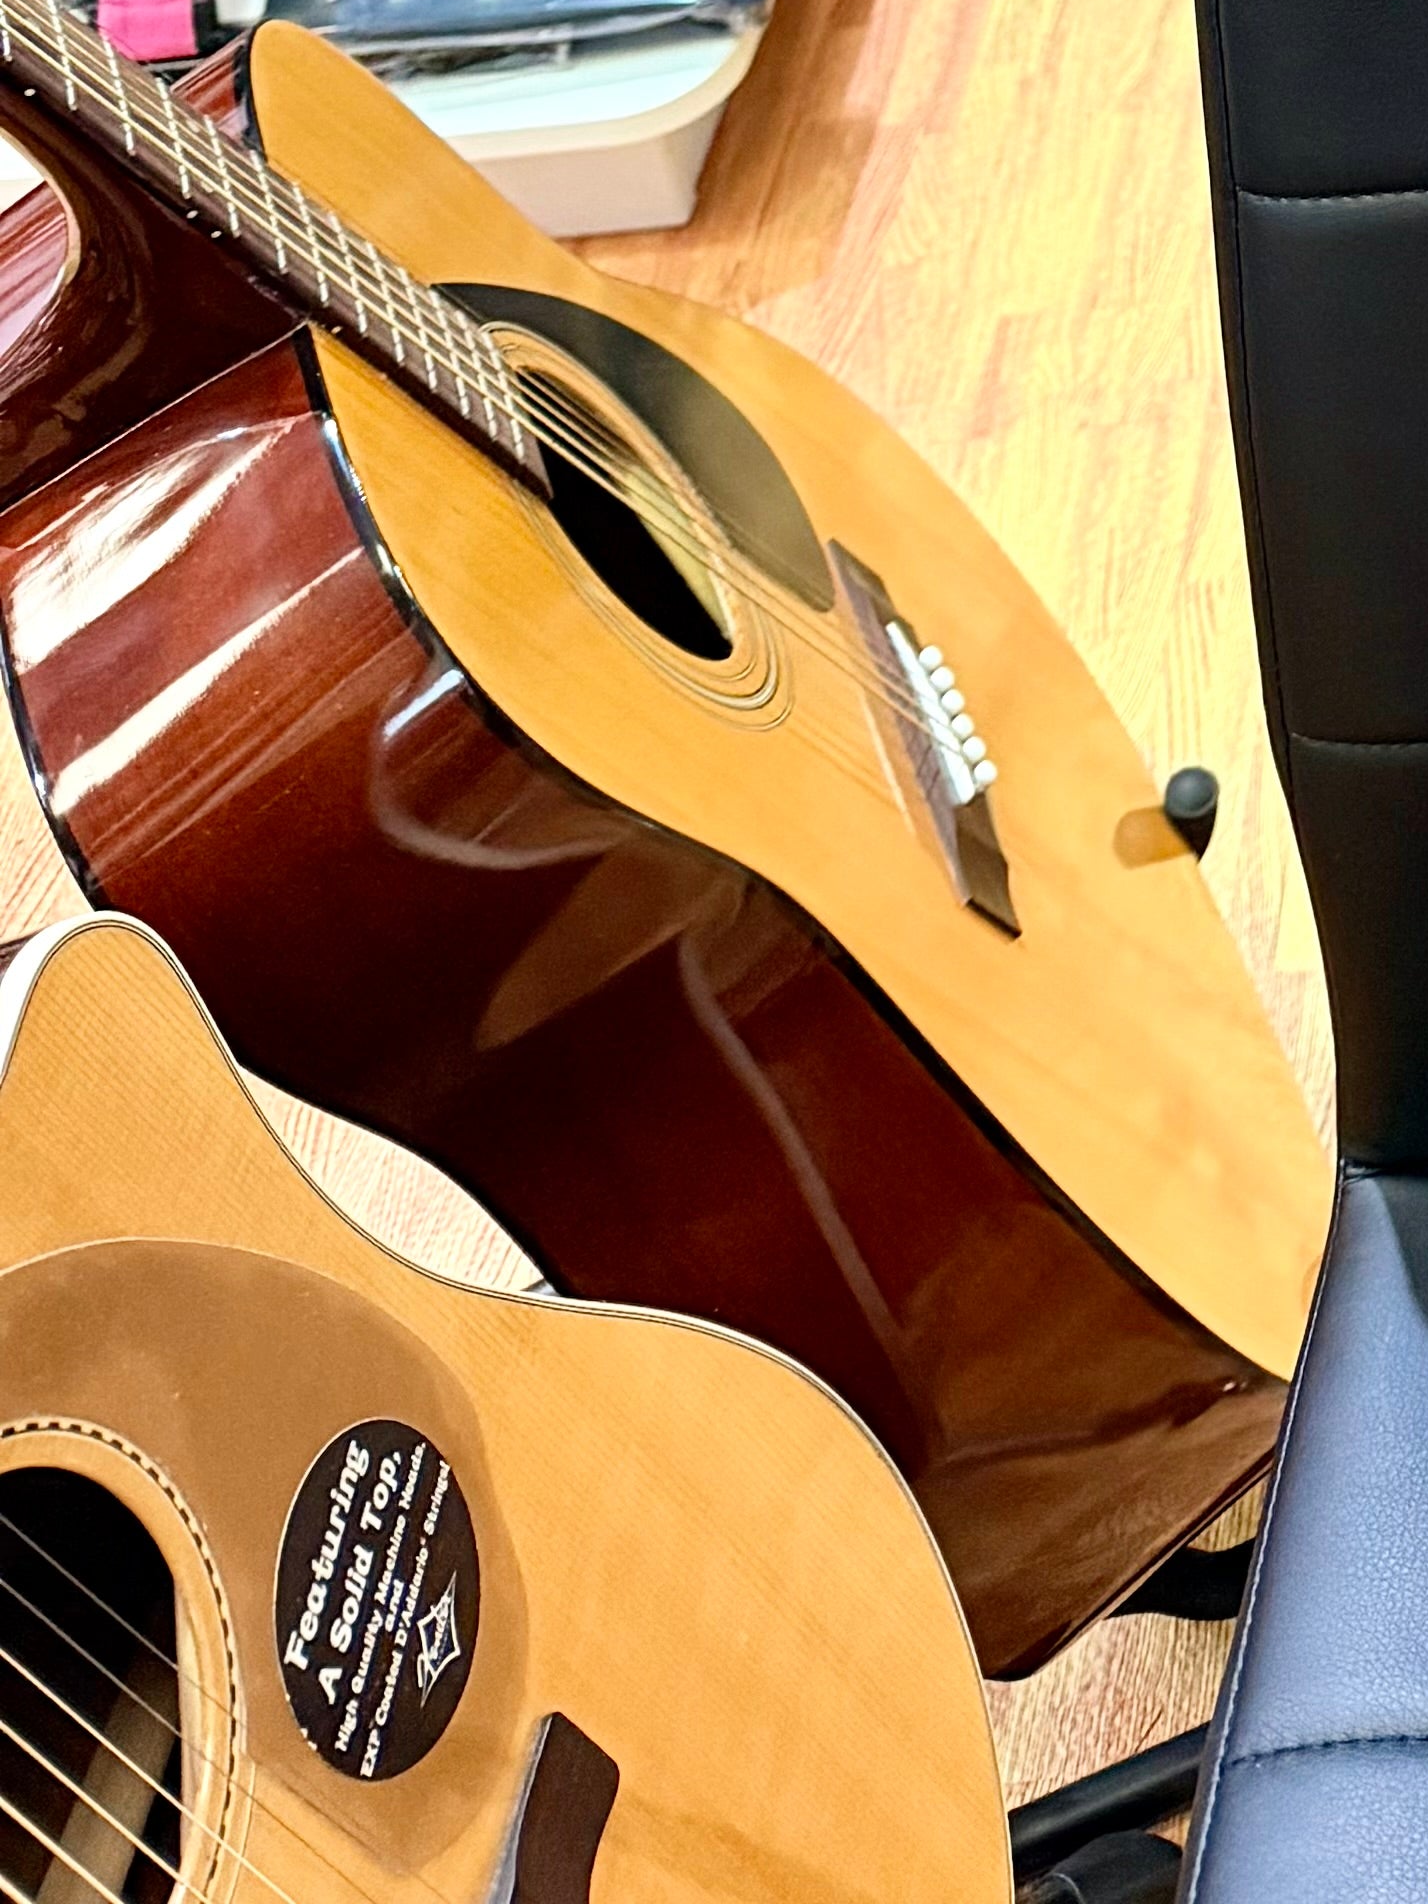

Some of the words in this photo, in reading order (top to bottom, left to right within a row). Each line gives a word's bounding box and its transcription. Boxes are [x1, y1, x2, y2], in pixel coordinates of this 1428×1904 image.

[360, 1450, 403, 1532] Top,
[283, 1438, 371, 1672] Featuring
[329, 1544, 375, 1655] Solid
[374, 1651, 403, 1727] Coated
[423, 1459, 451, 1537] Strings!
[384, 1578, 405, 1633] and
[317, 1664, 344, 1706] A
[334, 1698, 360, 1753] High
[351, 1607, 384, 1695] Quality
[374, 1513, 407, 1606] Machine
